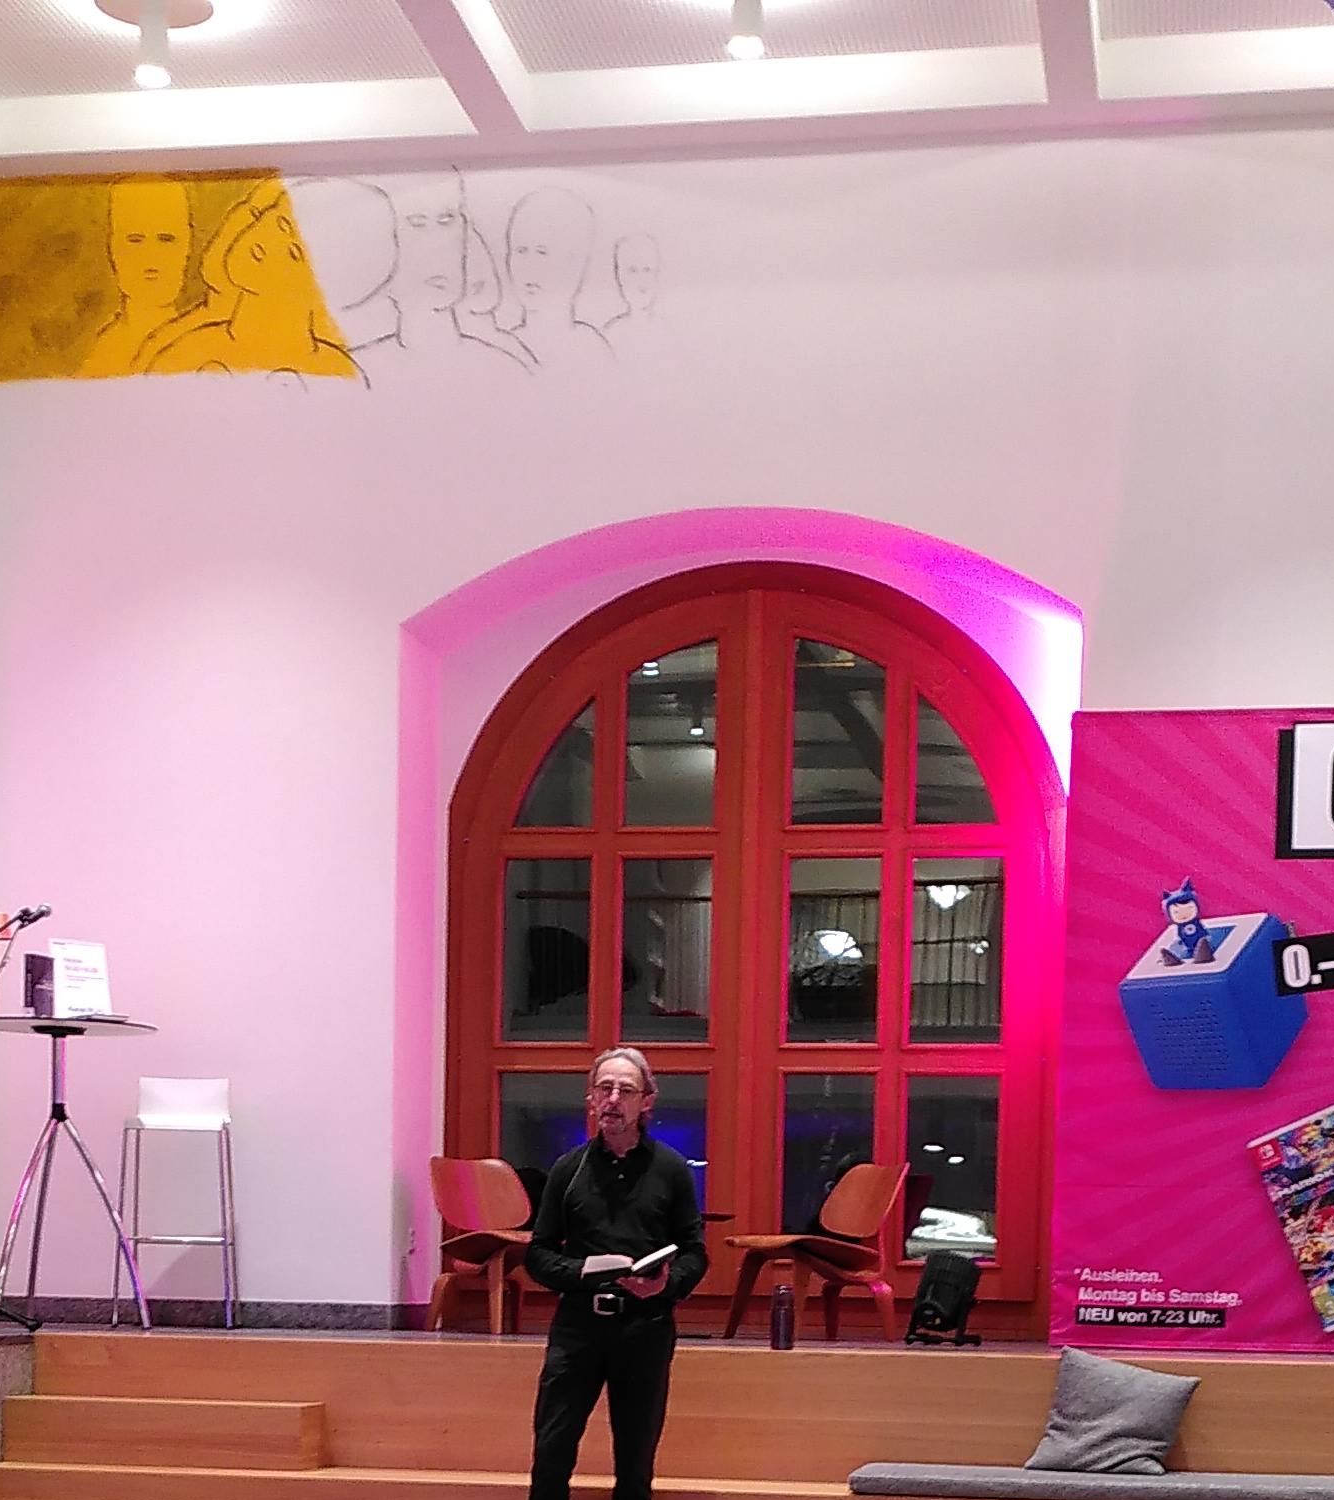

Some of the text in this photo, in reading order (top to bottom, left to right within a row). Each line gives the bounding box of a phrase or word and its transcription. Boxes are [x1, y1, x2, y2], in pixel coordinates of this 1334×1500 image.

[1078, 1287, 1137, 1306] Montag
[1141, 1288, 1165, 1303] bis
[1078, 1307, 1222, 1325] NEU von 7-23 Uhr.
